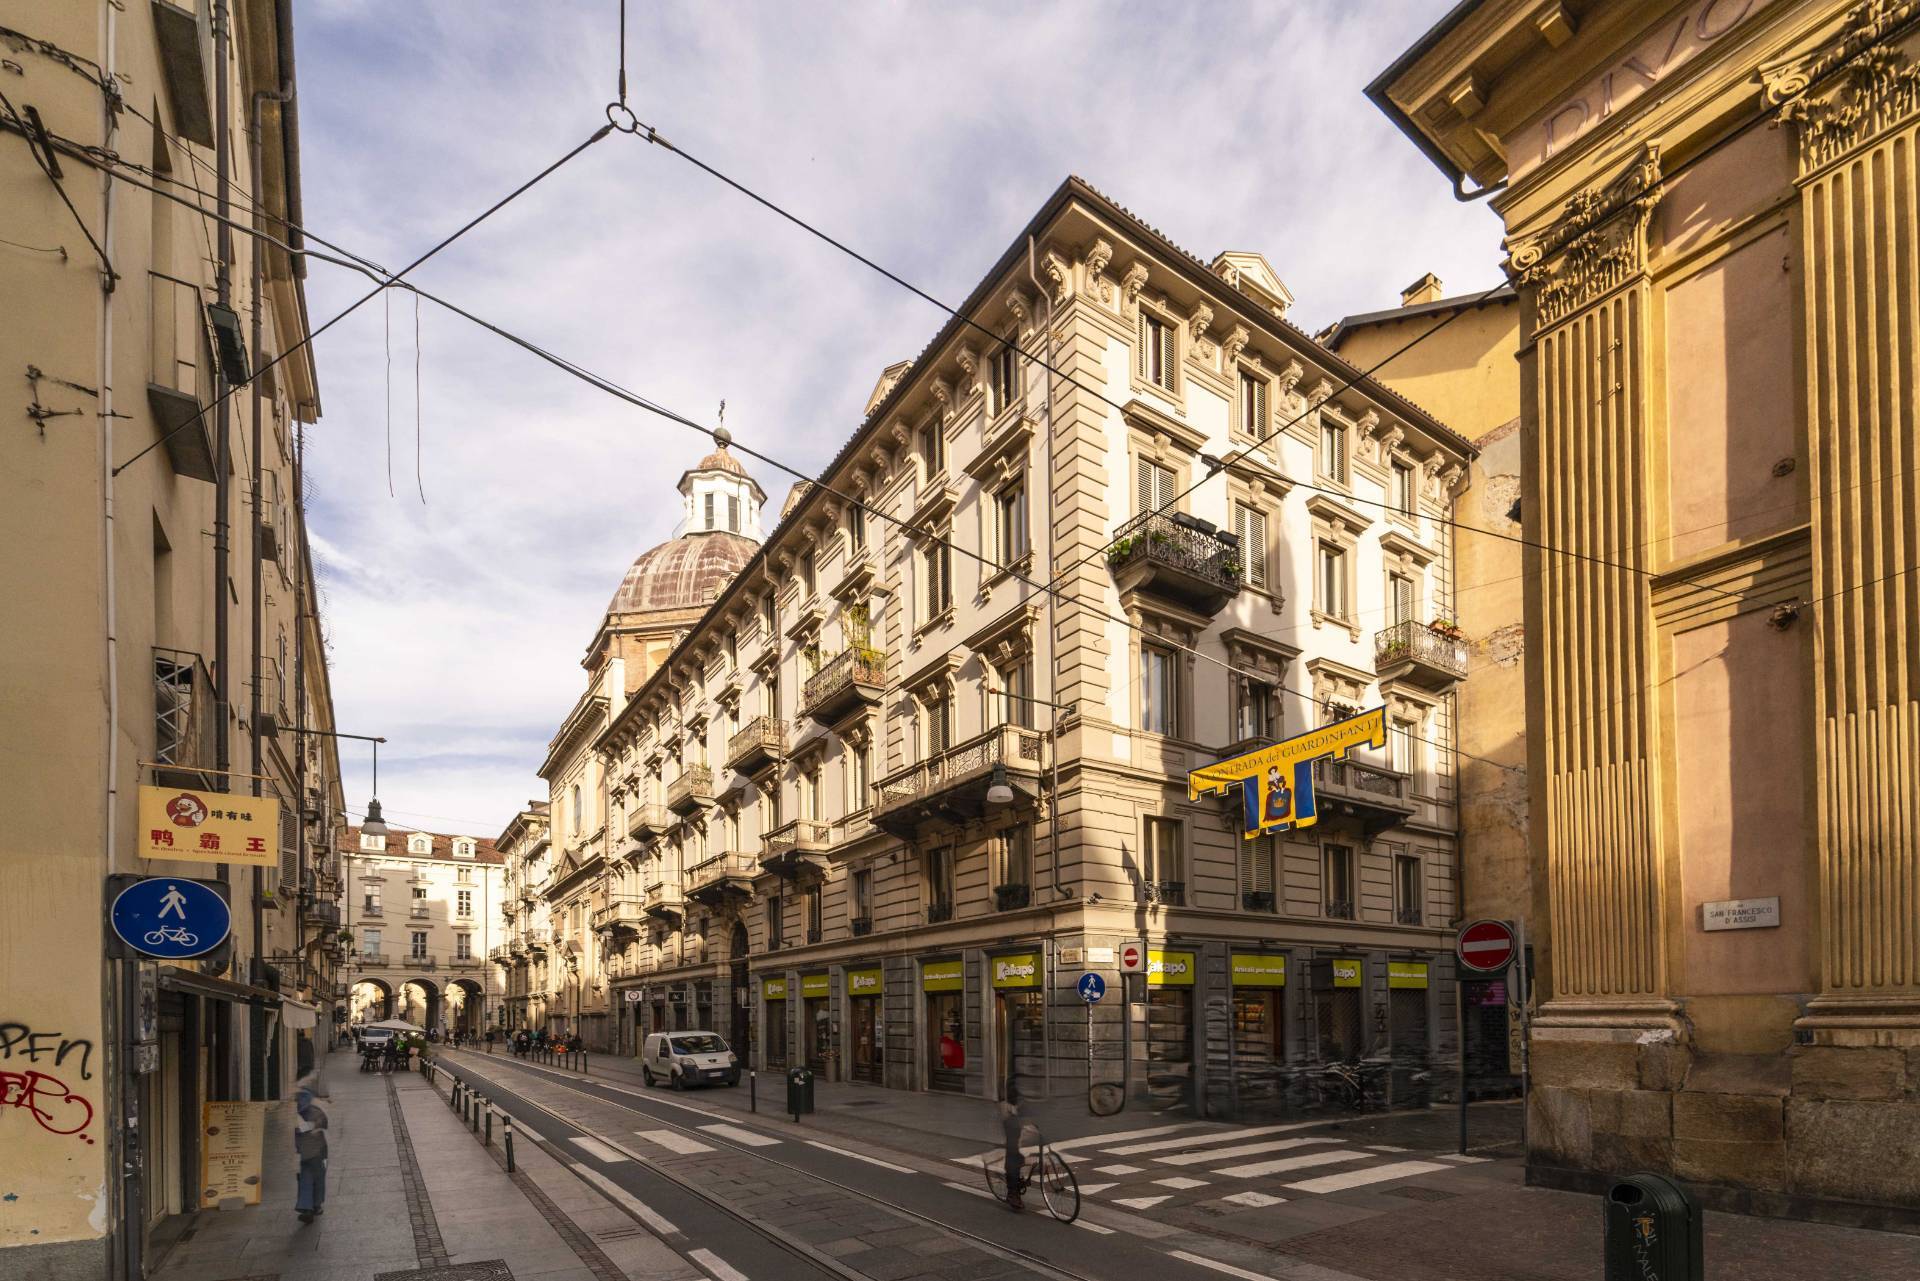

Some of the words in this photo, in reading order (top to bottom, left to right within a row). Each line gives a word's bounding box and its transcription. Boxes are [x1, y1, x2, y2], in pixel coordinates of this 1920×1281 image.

[1266, 753, 1281, 764] dei
[1282, 716, 1381, 759] GUARDINFANTI
[151, 828, 267, 854] 鸭霸王
[1710, 910, 1725, 918] SAN
[1727, 906, 1773, 917] FRANCESCO
